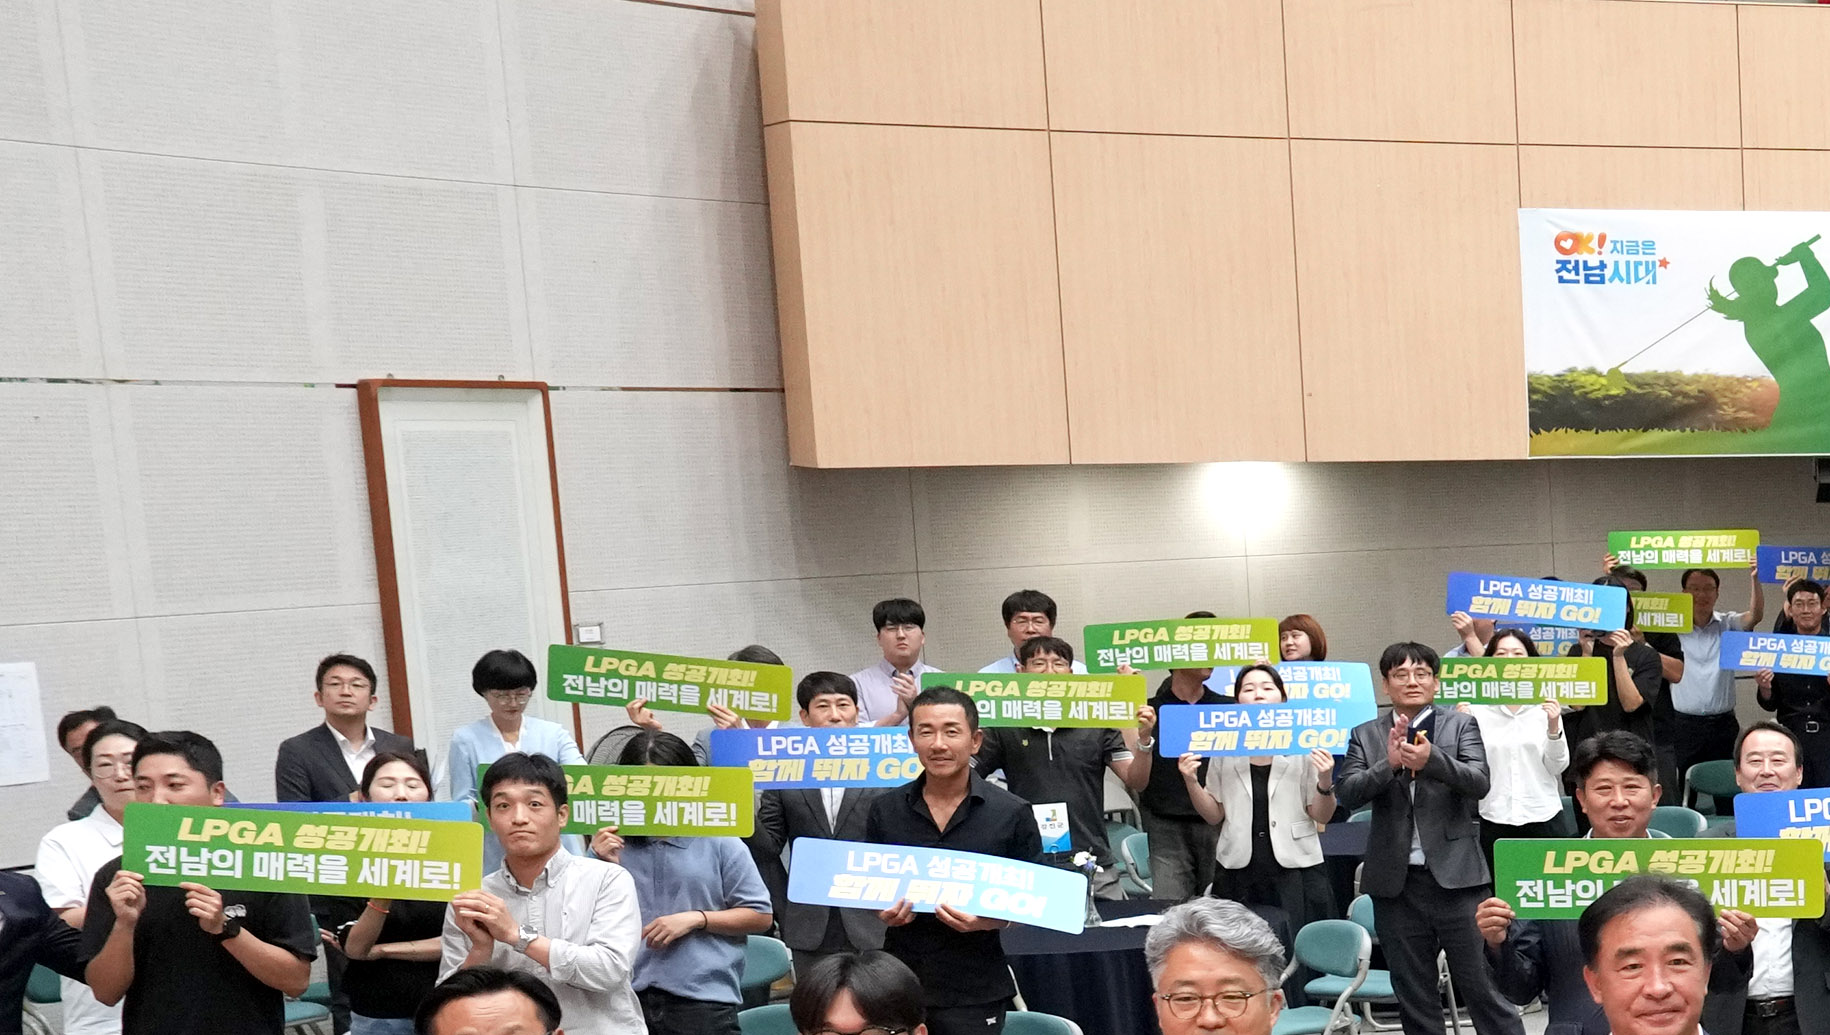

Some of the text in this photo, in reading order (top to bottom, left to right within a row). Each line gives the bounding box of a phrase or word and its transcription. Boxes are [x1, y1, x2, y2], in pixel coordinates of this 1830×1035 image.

[1608, 239, 1658, 257] 지금은
[1553, 256, 1658, 287] 전남시대
[1630, 536, 1675, 548] LPGA
[1618, 548, 1752, 564] 전남의 매력을 세계로!
[1781, 551, 1817, 564] LPGA
[1479, 579, 1594, 605] LPGA 성공개최!
[1468, 595, 1602, 624] 함께 뛰자 GO!
[1112, 624, 1251, 645] LPGA 성공개최!
[1748, 637, 1787, 651] LPGA
[1097, 644, 1209, 667] 전남의 매력을
[1739, 651, 1776, 667] 함께
[1779, 654, 1817, 671] 뛰자
[584, 656, 758, 688] LPGA 성공개최!
[1440, 662, 1579, 679] LPGA 성공개최!
[562, 674, 629, 699] 전남의
[1025, 680, 1113, 698] 성공개최!
[1481, 681, 1596, 700] 매력을 세계로!
[1002, 701, 1134, 721] 매력을 세계로!
[1199, 707, 1336, 727] LPGA 성공개최!
[758, 735, 820, 755] LPGA
[1188, 728, 1348, 752] 함께 뛰자 GO!
[812, 758, 870, 781] 뛰자
[573, 801, 737, 827] 매력을 세계로!
[177, 817, 431, 855] LPGA 성공개최!
[145, 843, 461, 890] 전남의 매력을 세계로!
[846, 850, 1035, 890] LPGA 성공개최!
[1543, 848, 1777, 874] LPGA 성공개최!
[827, 873, 1047, 920] 함께 GO!
[1710, 878, 1806, 909] 세계로!
